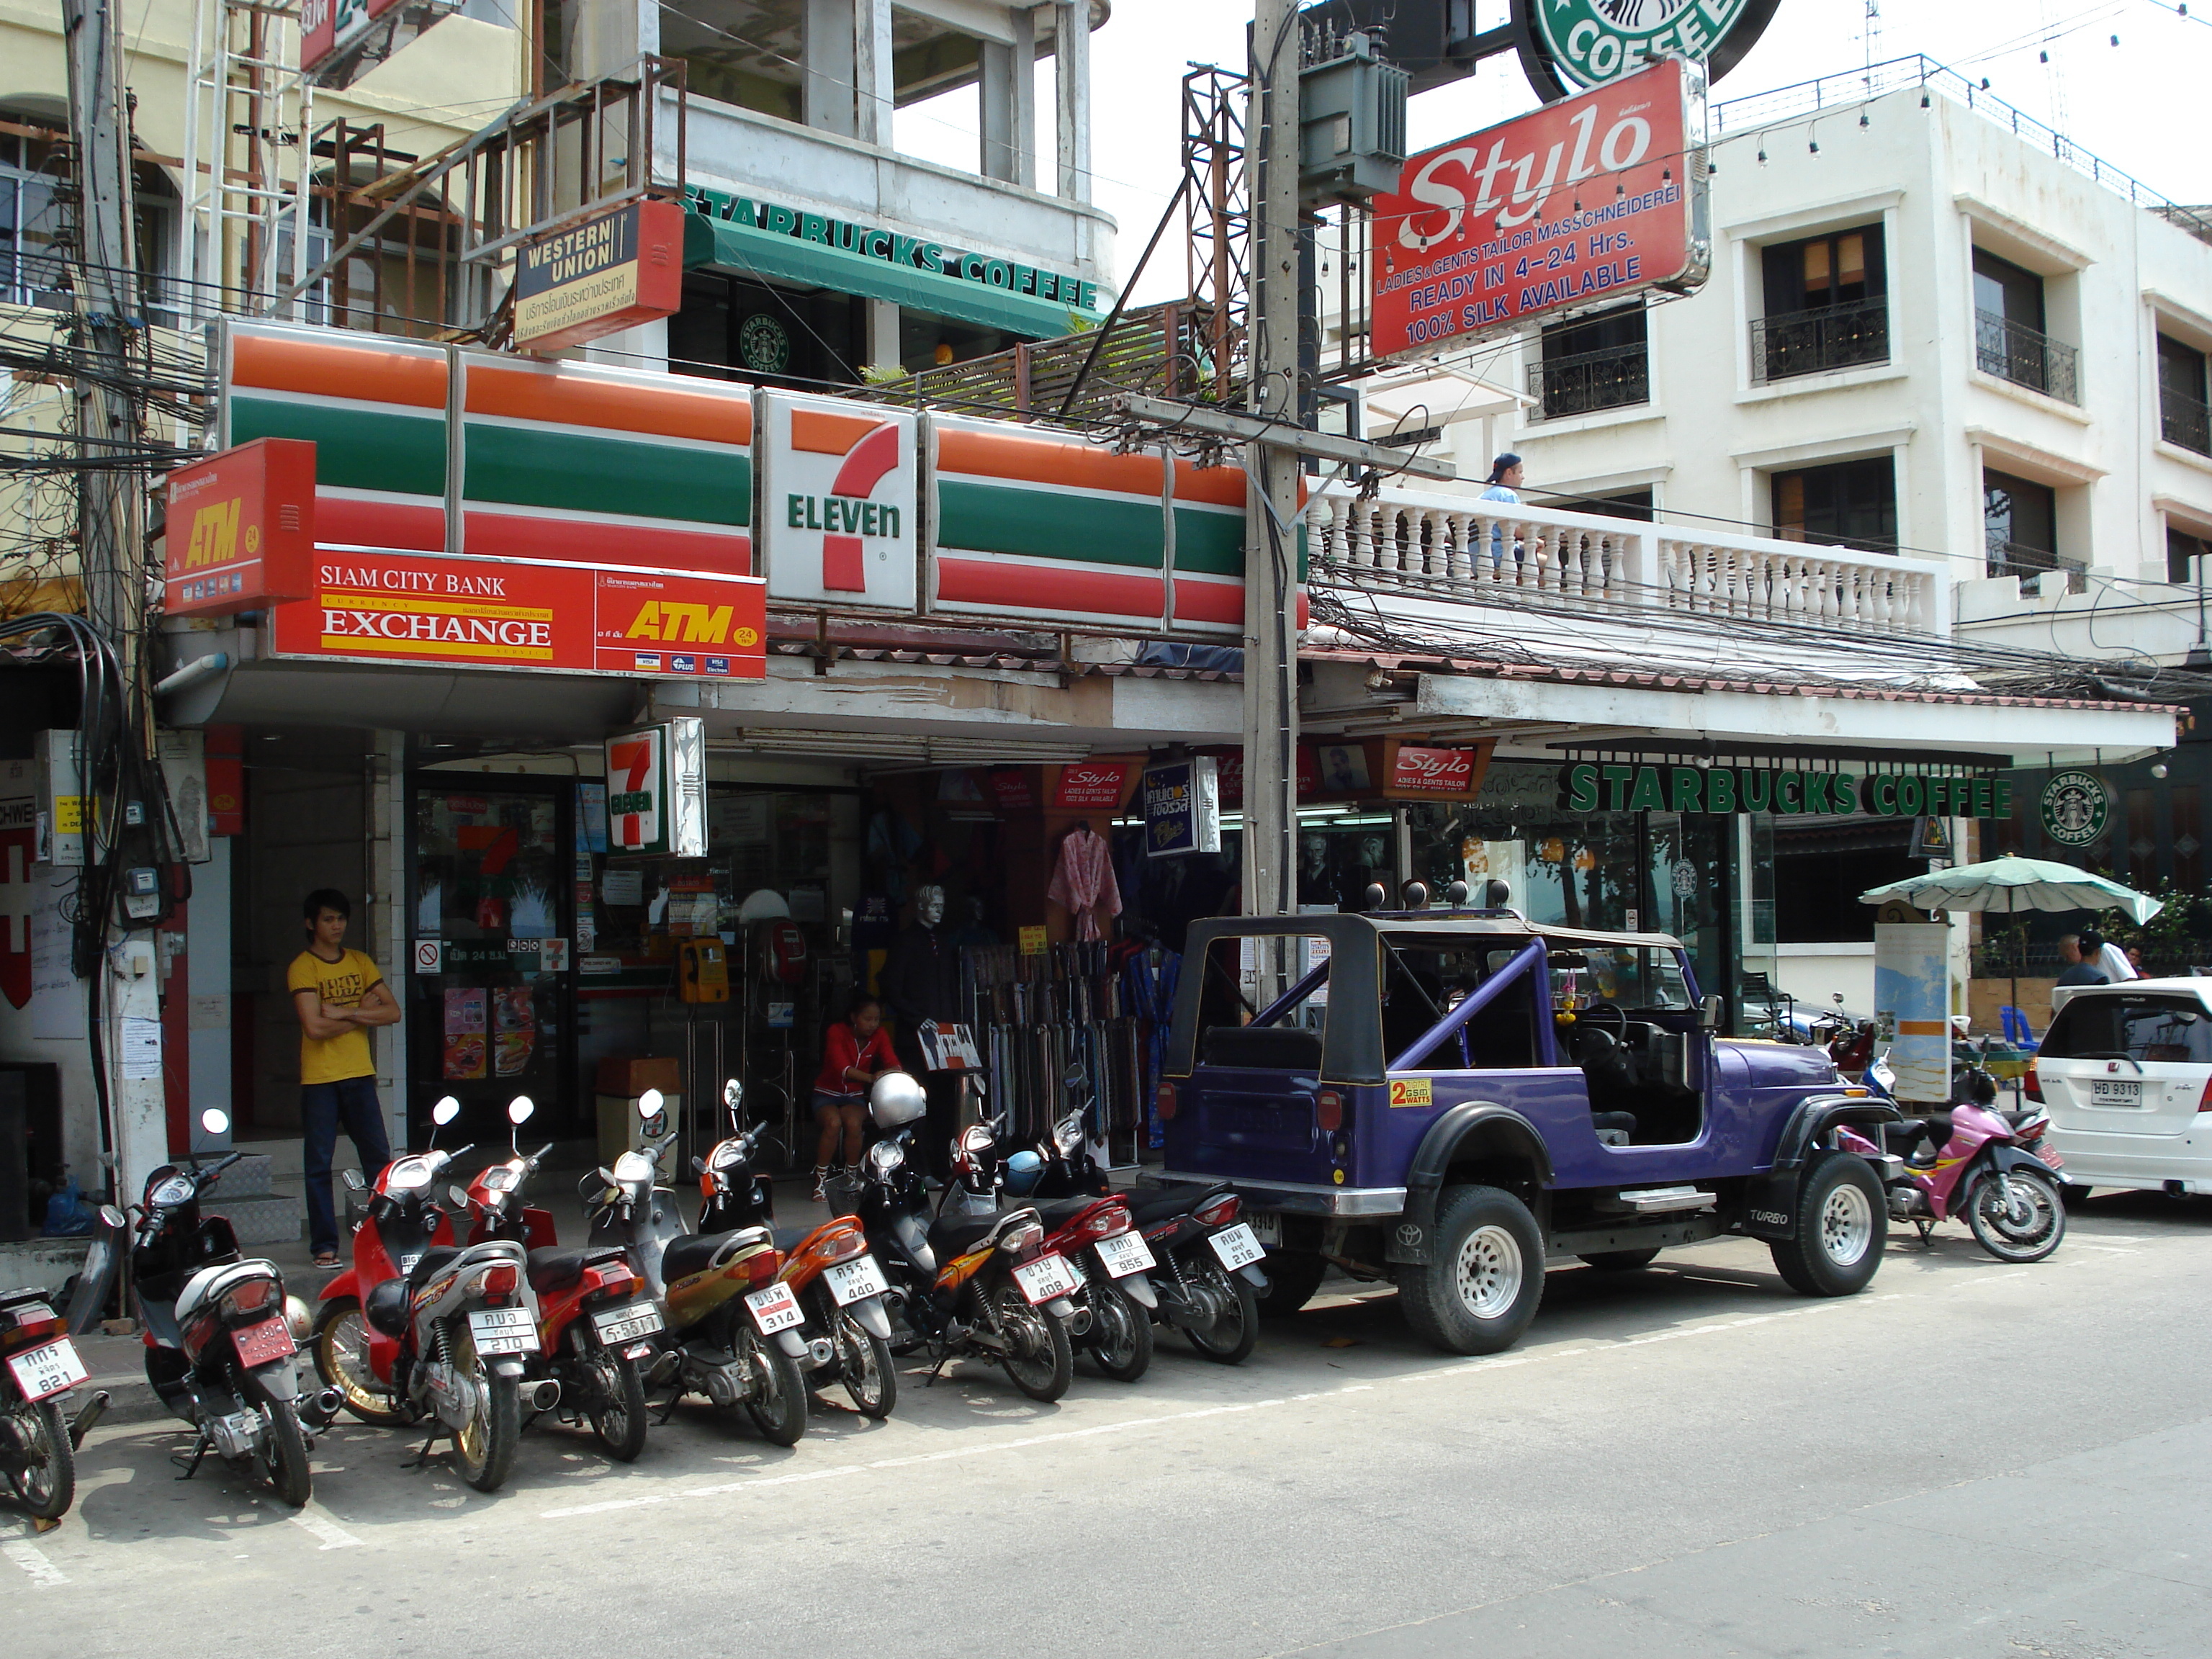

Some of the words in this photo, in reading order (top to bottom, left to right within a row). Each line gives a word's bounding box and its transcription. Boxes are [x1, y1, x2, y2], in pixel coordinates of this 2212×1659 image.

[1398, 104, 1651, 249] Stylo
[528, 219, 611, 269] WESTERN
[683, 184, 944, 274] STARBUCKS
[961, 253, 1097, 311] COFFEE
[1376, 266, 1424, 296] LADIES
[1424, 266, 1431, 279] &
[1432, 249, 1478, 274] GENTS
[1481, 232, 1532, 264] TAILOR
[1537, 185, 1681, 243] MASSCHNEIDEREI
[552, 243, 610, 283] UNION
[1410, 270, 1478, 312] READY
[1484, 262, 1505, 289] IN
[1590, 230, 1635, 258] Hrs.
[1406, 311, 1455, 344] 100%
[1462, 295, 1509, 328] SILK
[1519, 256, 1641, 313] AVAILABLE
[742, 314, 787, 346] STARBUCKS
[747, 353, 782, 374] COFFEE
[791, 408, 899, 593] 7
[185, 497, 241, 570] ATM
[320, 565, 378, 587] SIAM
[383, 569, 438, 592] CITY
[446, 574, 506, 596] BANK
[326, 597, 410, 609] CURRENCY
[321, 609, 552, 647] EXCHANGE
[625, 600, 734, 644] ATM
[739, 630, 752, 639] 24
[678, 662, 694, 672] PLUS
[1396, 753, 1470, 778] Stylo
[1068, 771, 1120, 786] Stylo
[1570, 764, 1856, 815] STARBUCKS
[1873, 774, 2013, 819] COFFEE
[2043, 774, 2105, 806] STARBUCKS
[2051, 823, 2097, 841] COFFEE
[472, 951, 486, 961] 24
[1393, 1082, 1406, 1105] 2
[2113, 1083, 2139, 1096] 9313
[1750, 1210, 1788, 1225] TURBO
[1119, 1258, 1143, 1272] 955
[1232, 1249, 1255, 1264] 216
[849, 1282, 875, 1299] 440
[1040, 1280, 1064, 1297] 408
[766, 1311, 796, 1328] 314
[494, 1326, 514, 1336] ชลบุรี
[491, 1338, 523, 1351] 210
[39, 1371, 71, 1393] 821
